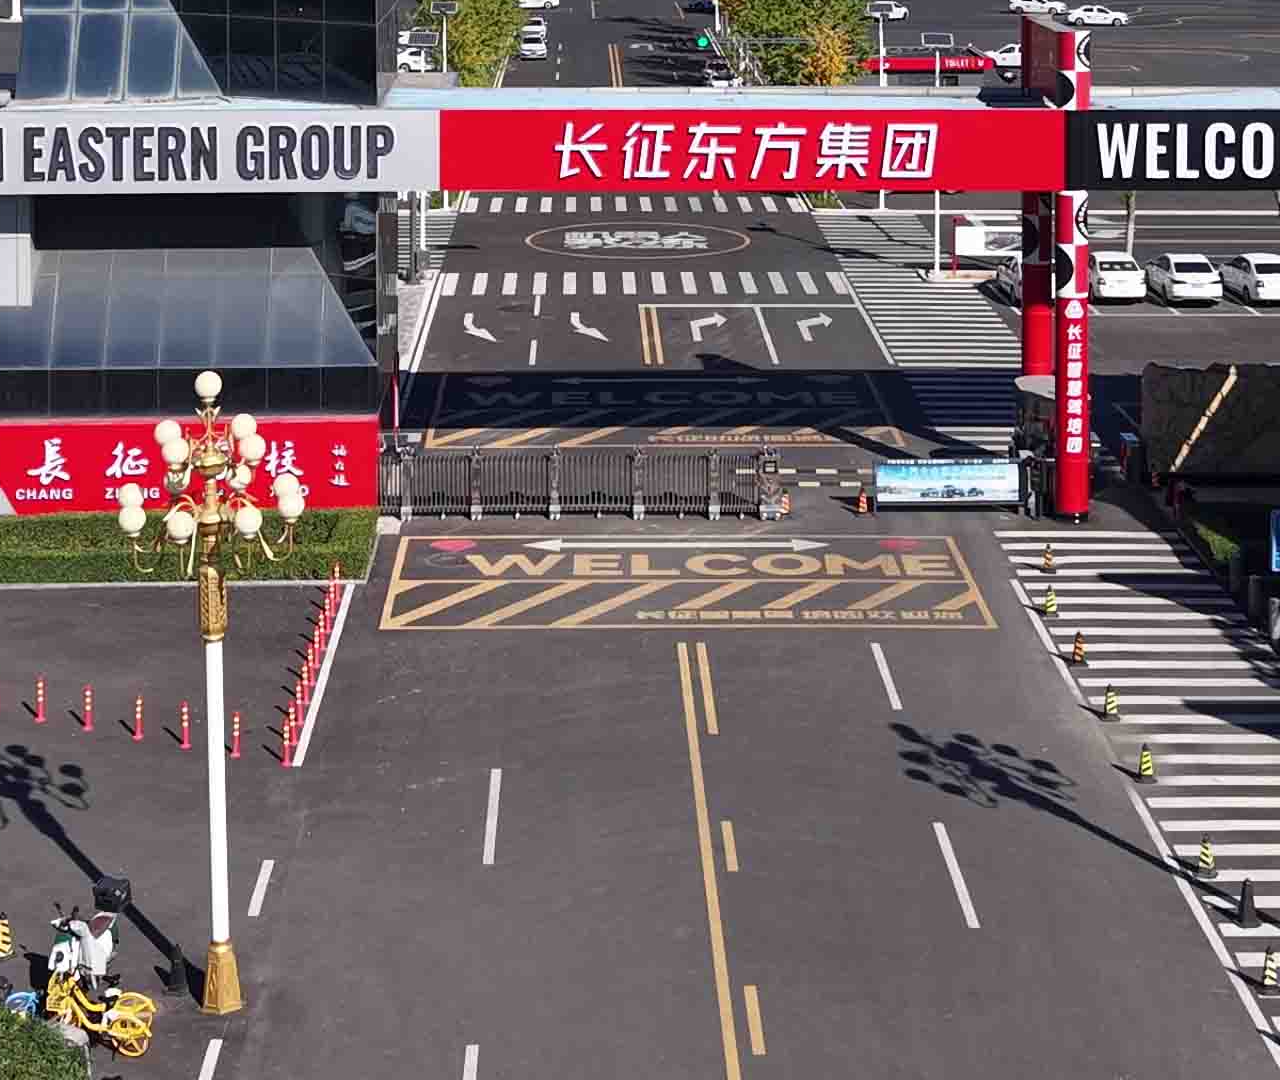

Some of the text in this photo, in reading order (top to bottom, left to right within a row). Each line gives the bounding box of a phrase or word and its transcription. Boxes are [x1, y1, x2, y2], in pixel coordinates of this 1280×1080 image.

[23, 126, 219, 183] EASTERN
[236, 124, 396, 182] GROUP
[554, 121, 939, 181] 长征东方集团
[468, 390, 858, 406] WELCOME
[26, 436, 305, 486] 長征校
[15, 487, 73, 501] CHANG
[466, 552, 956, 578] WELCOME
